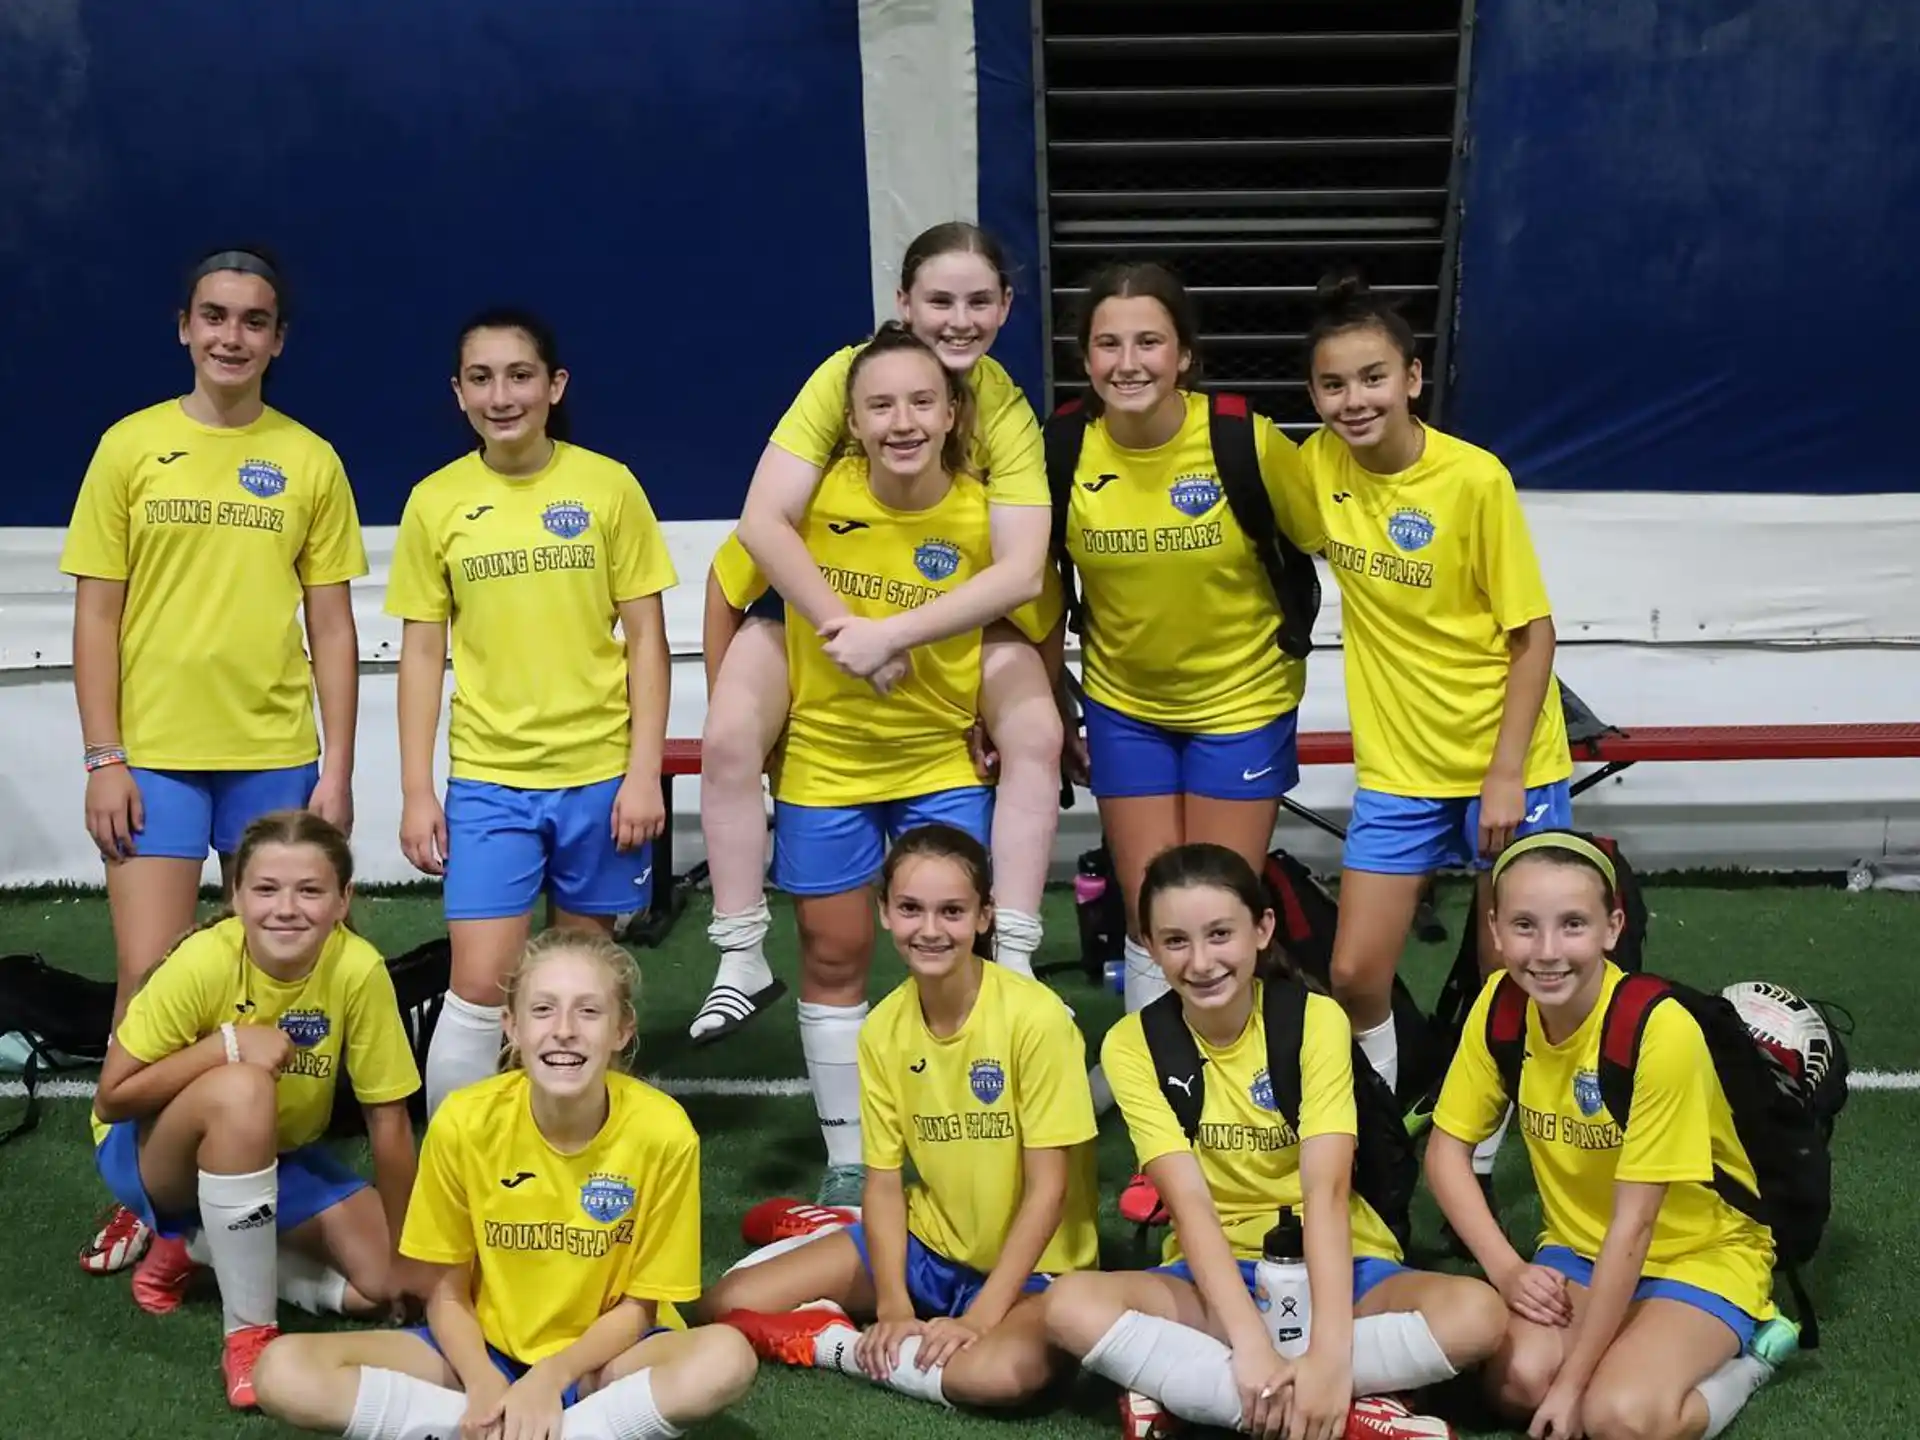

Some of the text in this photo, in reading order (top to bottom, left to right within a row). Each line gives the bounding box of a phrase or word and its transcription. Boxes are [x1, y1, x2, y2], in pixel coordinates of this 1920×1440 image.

[1173, 492, 1218, 503] FUTSAL
[145, 499, 284, 533] YOUNG STARZ
[1082, 521, 1223, 554] YOUNG STARZ
[462, 544, 596, 582] YOUNG STARZ
[1369, 551, 1434, 588] STARZ
[583, 1194, 630, 1207] FUTSAL
[485, 1219, 564, 1251] YOUNG
